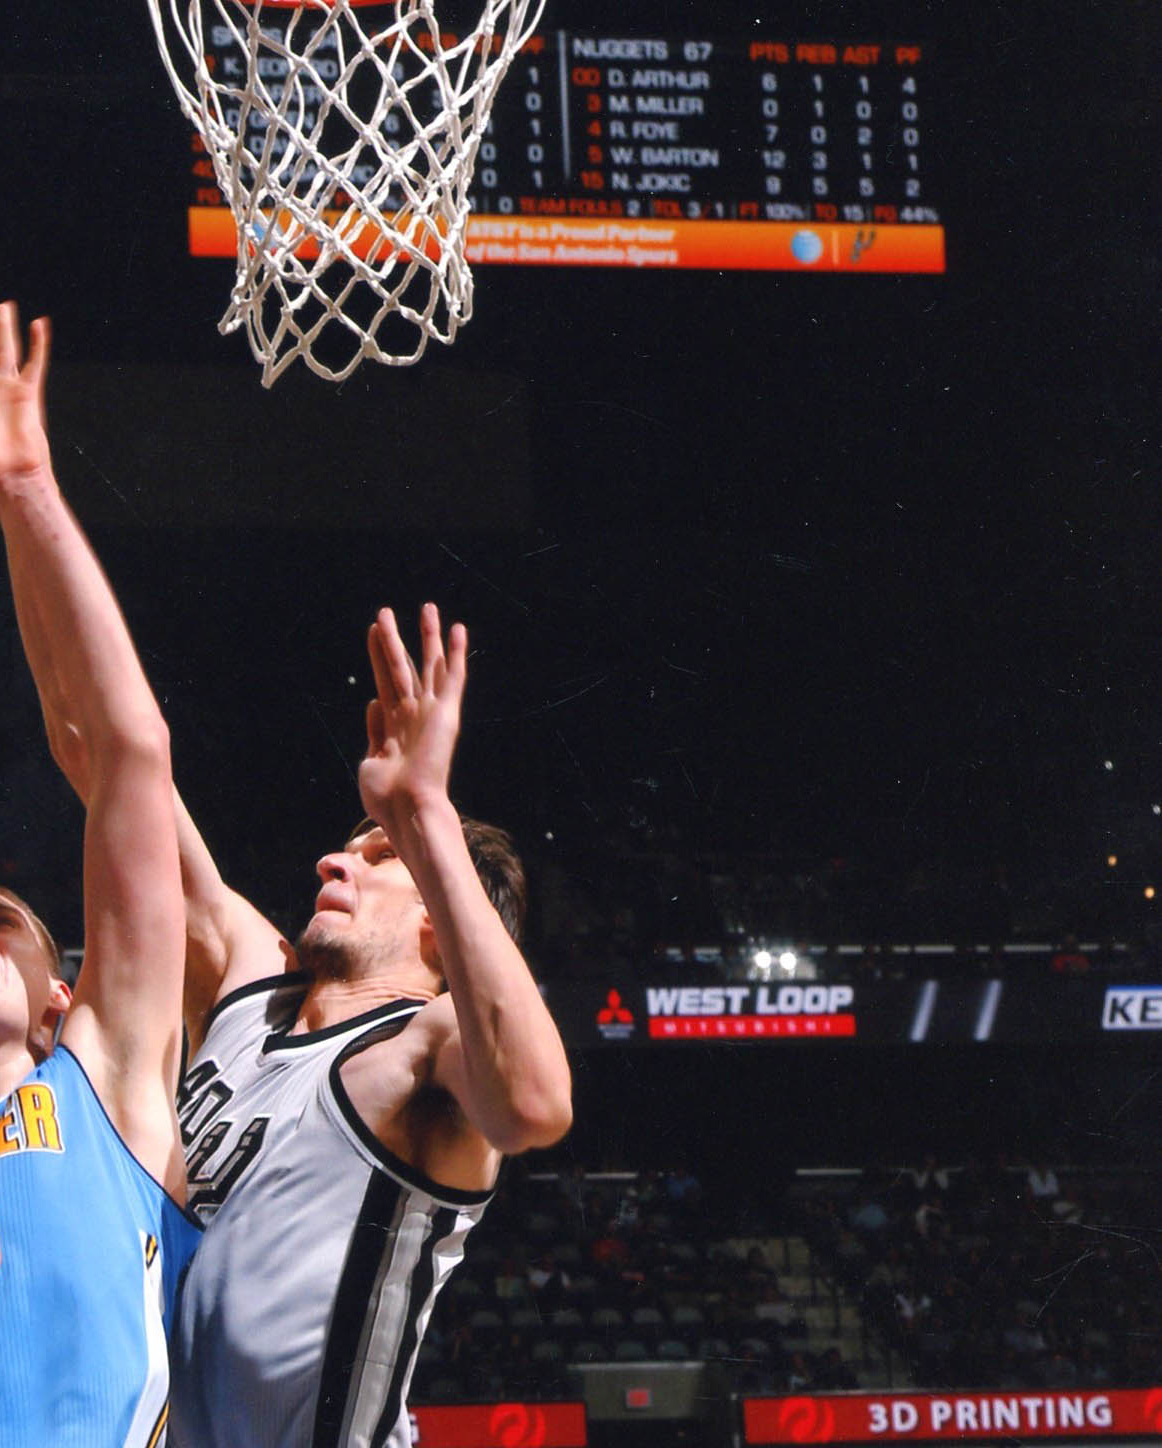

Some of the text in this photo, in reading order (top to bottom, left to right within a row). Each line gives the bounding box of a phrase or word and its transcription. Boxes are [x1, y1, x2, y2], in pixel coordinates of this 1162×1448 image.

[572, 37, 922, 65] NUGGETS 67 PTS REB AST PF
[632, 69, 710, 89] ARTHUR
[901, 76, 916, 95] 4
[635, 95, 705, 115] MILLER
[762, 98, 778, 118] 0
[856, 100, 872, 121] 0
[902, 101, 919, 121] 0
[632, 121, 680, 141] FOYE
[810, 125, 827, 145] 0
[903, 127, 919, 147] 0
[640, 147, 720, 167] BARTON
[636, 173, 692, 193] JOKIC
[551, 223, 605, 241] Proud
[607, 224, 676, 242] Partner
[519, 243, 552, 260] San
[553, 244, 625, 262] Antonio
[627, 245, 678, 268] Spurs
[646, 985, 854, 1017] WEST LOOP
[868, 1396, 1114, 1433] 3D PRINTING
